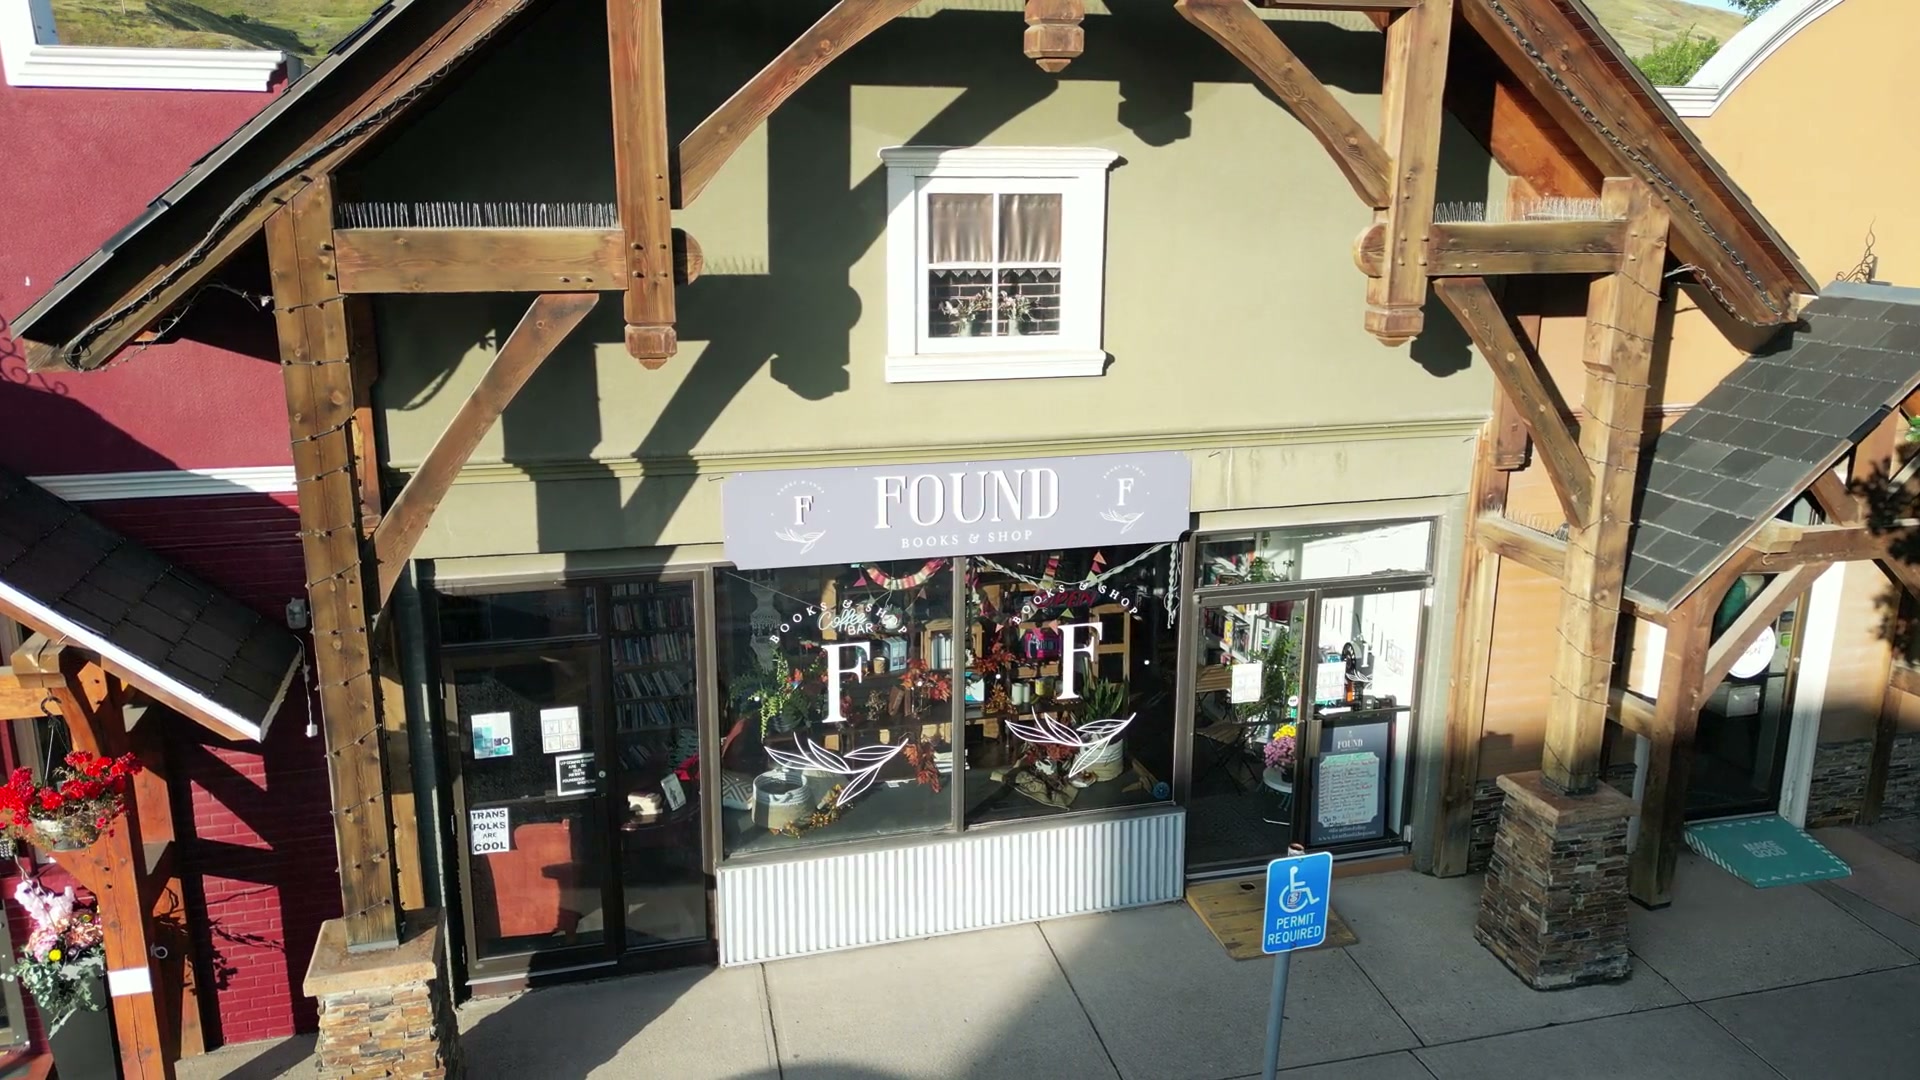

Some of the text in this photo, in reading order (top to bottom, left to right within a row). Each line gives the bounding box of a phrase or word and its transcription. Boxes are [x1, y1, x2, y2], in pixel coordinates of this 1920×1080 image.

[873, 467, 1059, 529] FOUND
[1116, 478, 1134, 506] F
[794, 495, 813, 525] F
[902, 530, 1033, 548] BOOKS & SHOP
[1013, 581, 1138, 625] BOOKS & SHOP
[769, 599, 908, 644] BOOKS & SHOP
[818, 608, 868, 632] Coffee
[848, 623, 874, 635] BAR
[1056, 622, 1103, 700] F
[821, 641, 871, 723] F
[1337, 739, 1364, 750] FOUND
[471, 810, 506, 820] TRANS
[473, 821, 506, 831] FOLKS
[474, 841, 507, 852] COOL
[1276, 912, 1315, 930] PERMIT
[1267, 925, 1321, 946] REQUIRED
